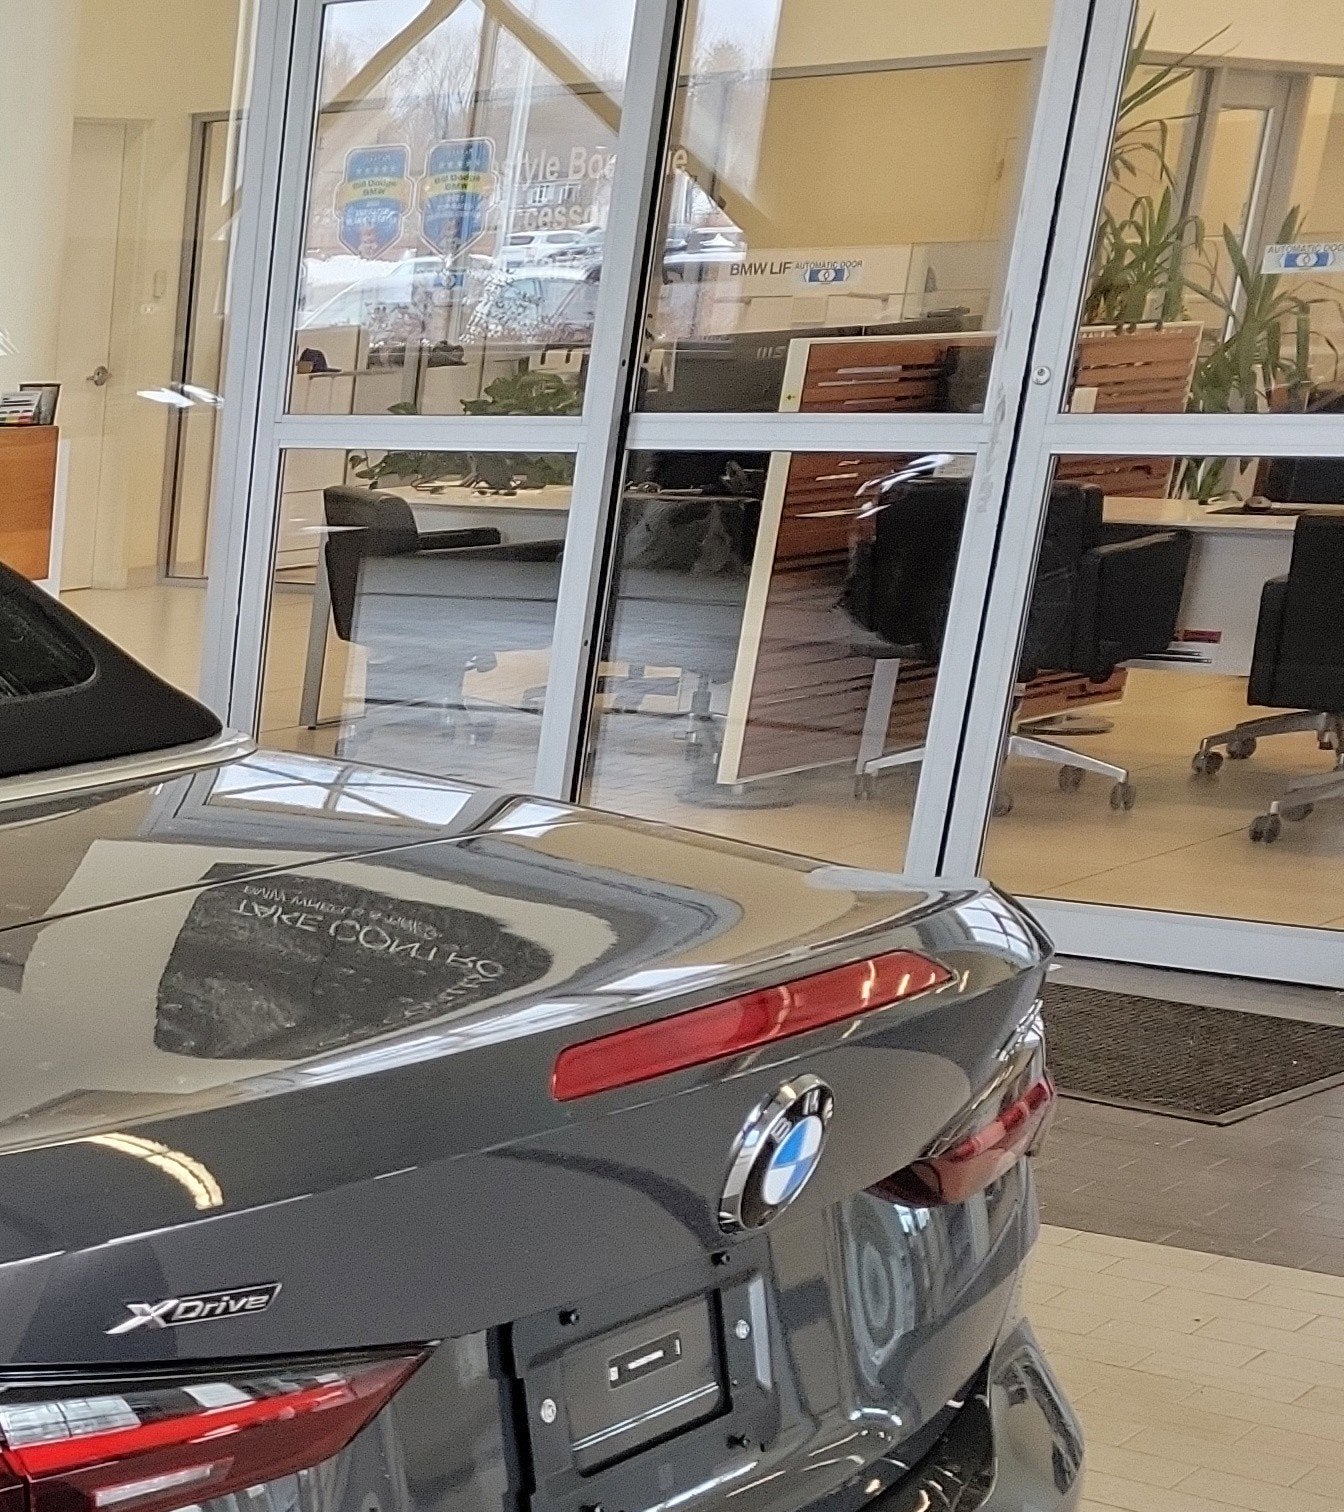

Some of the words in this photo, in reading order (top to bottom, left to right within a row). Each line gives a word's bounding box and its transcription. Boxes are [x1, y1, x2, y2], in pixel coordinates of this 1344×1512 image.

[1268, 244, 1322, 254] AUTOMATIC
[1324, 243, 1344, 252] DOO
[730, 262, 768, 277] BMW
[795, 260, 838, 270] AUTOMATIC
[840, 259, 863, 269] DOOR
